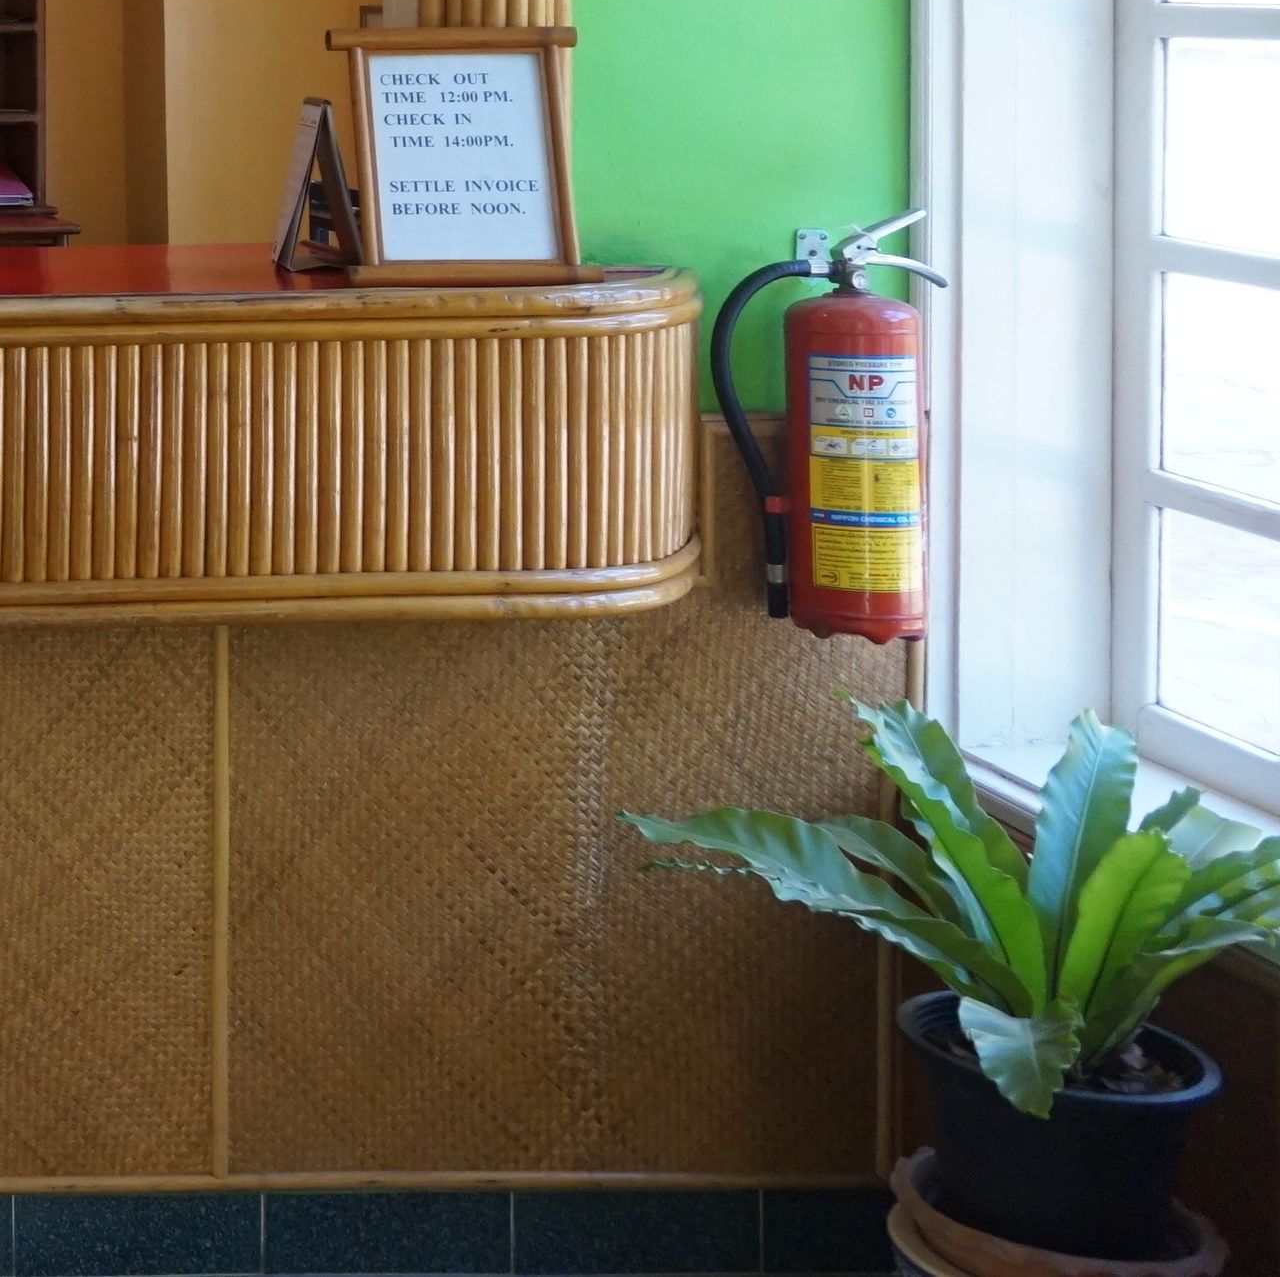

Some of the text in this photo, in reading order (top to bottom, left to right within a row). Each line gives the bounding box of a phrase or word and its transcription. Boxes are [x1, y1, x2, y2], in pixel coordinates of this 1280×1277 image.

[380, 73, 489, 86] CHECK OUT
[381, 91, 513, 104] TIME 12:00 PM.
[384, 113, 472, 126] CHECK IN
[390, 135, 514, 148] TIME 14:00PM.
[389, 179, 539, 193] SETTLE INVOICE
[392, 202, 526, 215] BEFORE NOON.
[848, 374, 884, 391] NP
